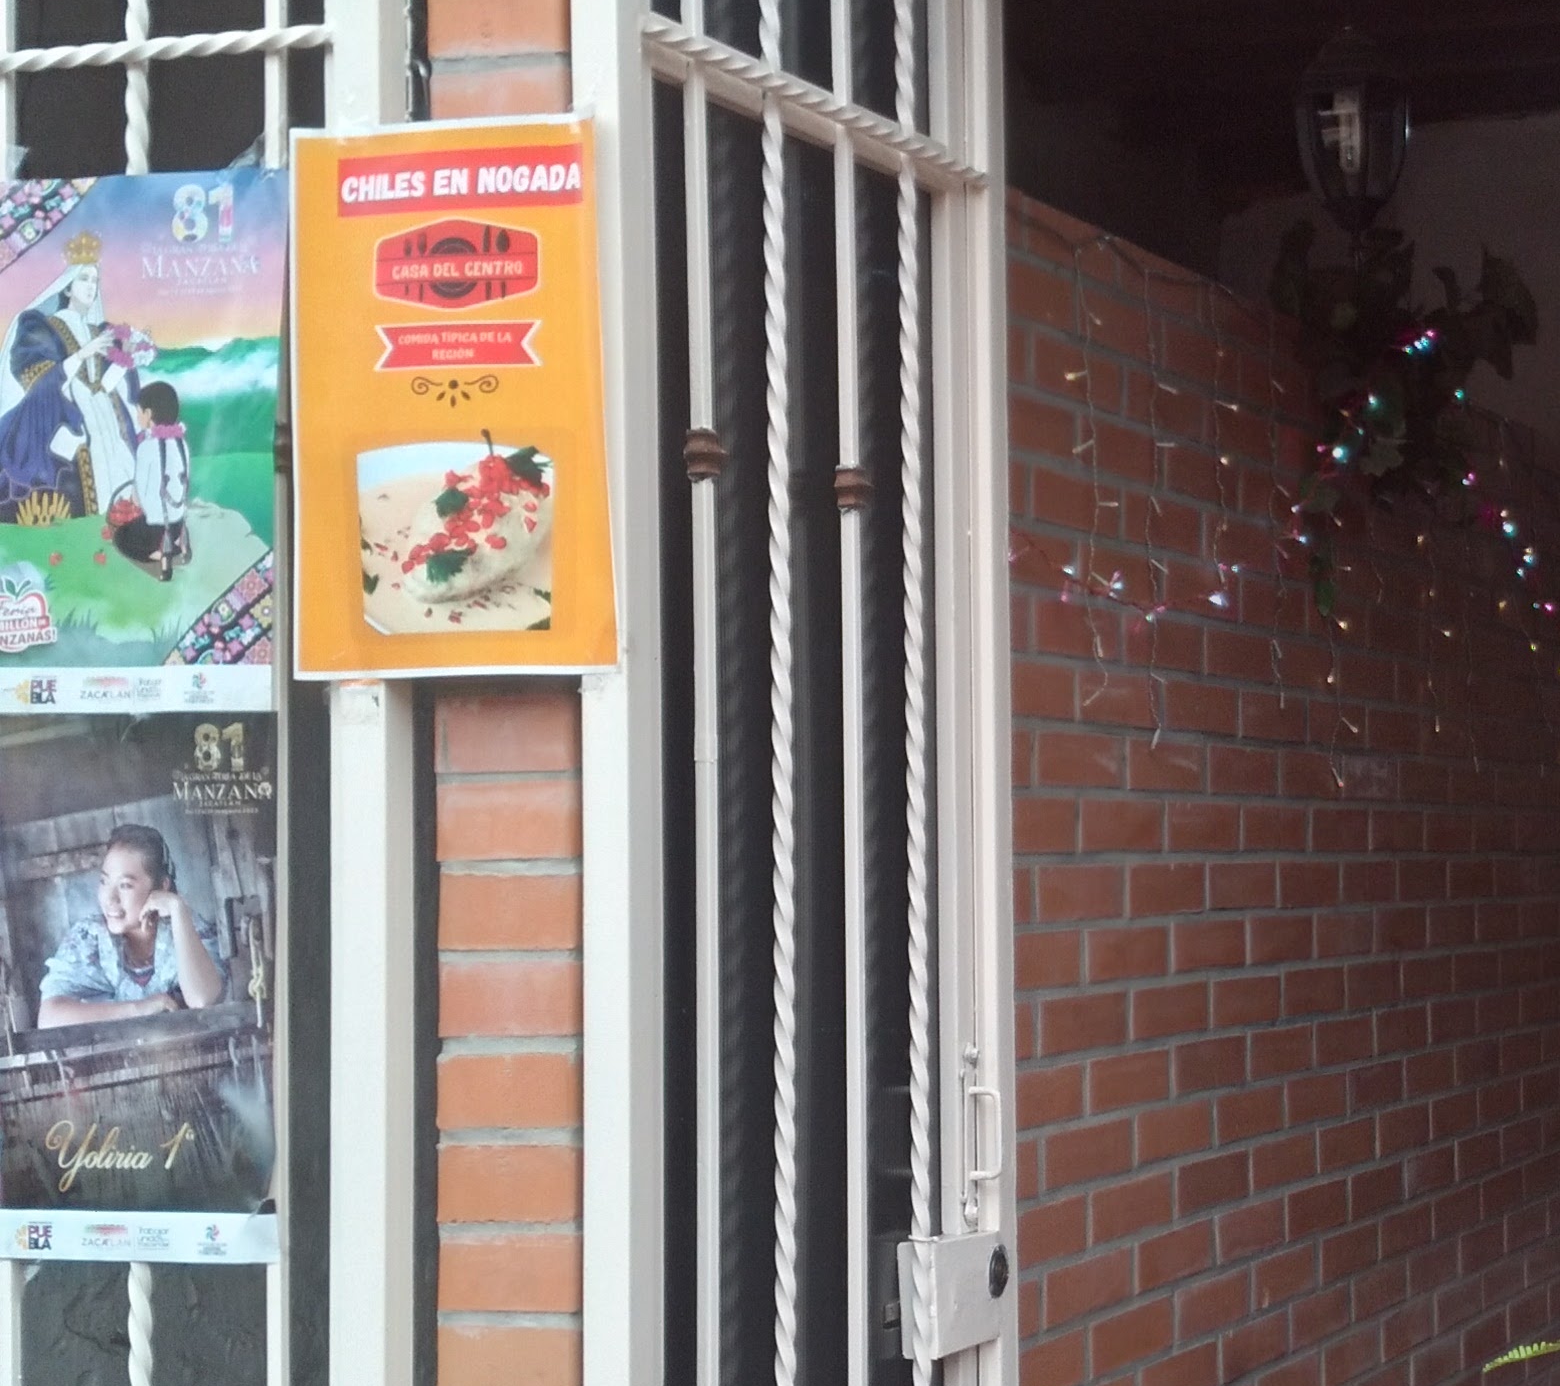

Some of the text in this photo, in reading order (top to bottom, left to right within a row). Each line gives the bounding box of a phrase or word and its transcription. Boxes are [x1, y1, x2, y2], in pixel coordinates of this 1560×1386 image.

[341, 162, 581, 204] CHILES EN NOGADA
[172, 182, 234, 243] 81
[142, 254, 261, 279] MANZANA
[392, 260, 524, 280] CASA DEL CENTRO
[398, 333, 439, 345] COMIDA
[479, 331, 494, 343] DE
[497, 331, 512, 342] LA
[194, 722, 245, 772] 81
[45, 1119, 153, 1193] Yoliria
